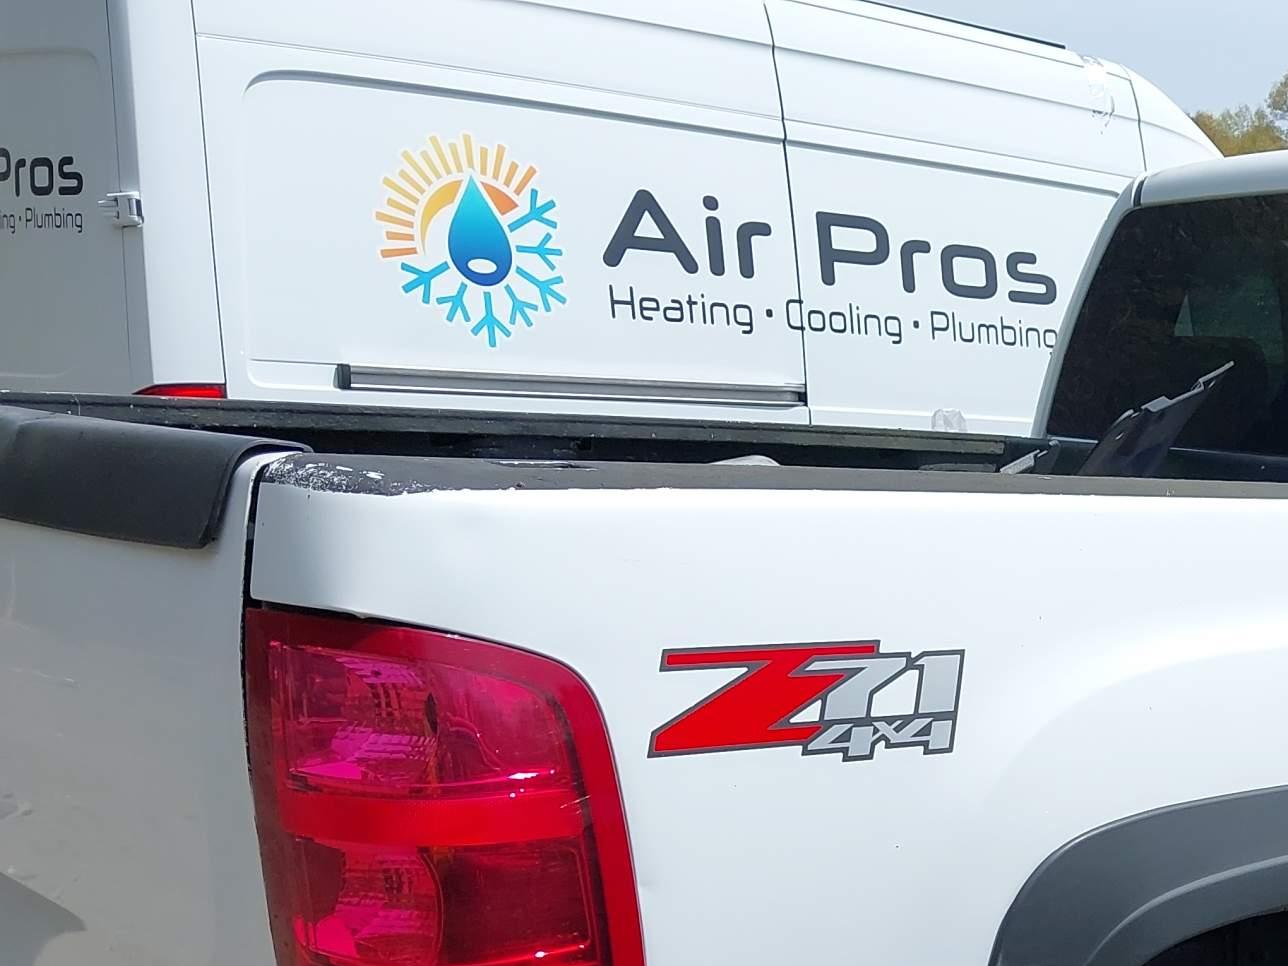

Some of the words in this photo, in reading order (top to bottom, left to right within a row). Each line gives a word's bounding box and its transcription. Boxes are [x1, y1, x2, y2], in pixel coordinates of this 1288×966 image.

[25, 207, 83, 233] Plumbing
[602, 188, 772, 278] Air
[815, 210, 1058, 305] Pros
[609, 284, 753, 334] Heating
[786, 299, 902, 344] Cooling
[647, 639, 965, 758] Z71
